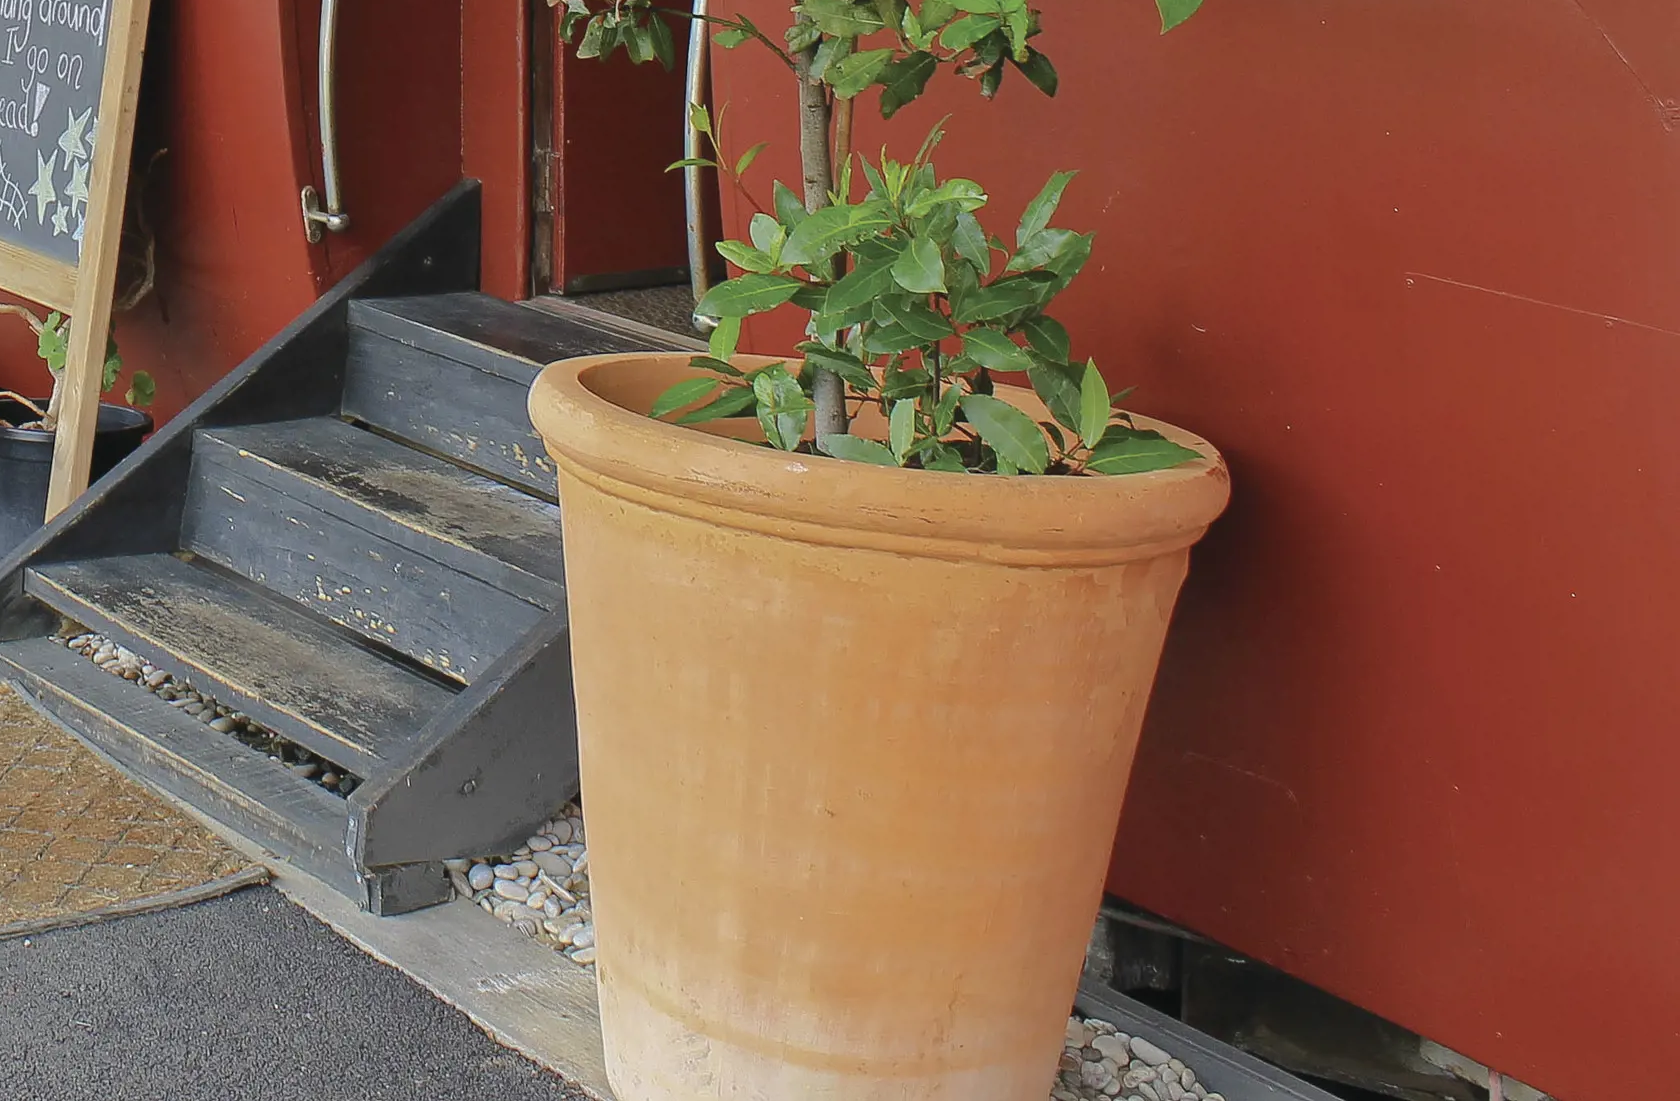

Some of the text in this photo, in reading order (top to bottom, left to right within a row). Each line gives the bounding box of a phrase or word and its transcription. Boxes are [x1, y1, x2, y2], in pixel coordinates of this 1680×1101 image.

[1, 26, 20, 65] I
[21, 45, 49, 93] go
[57, 53, 83, 90] on
